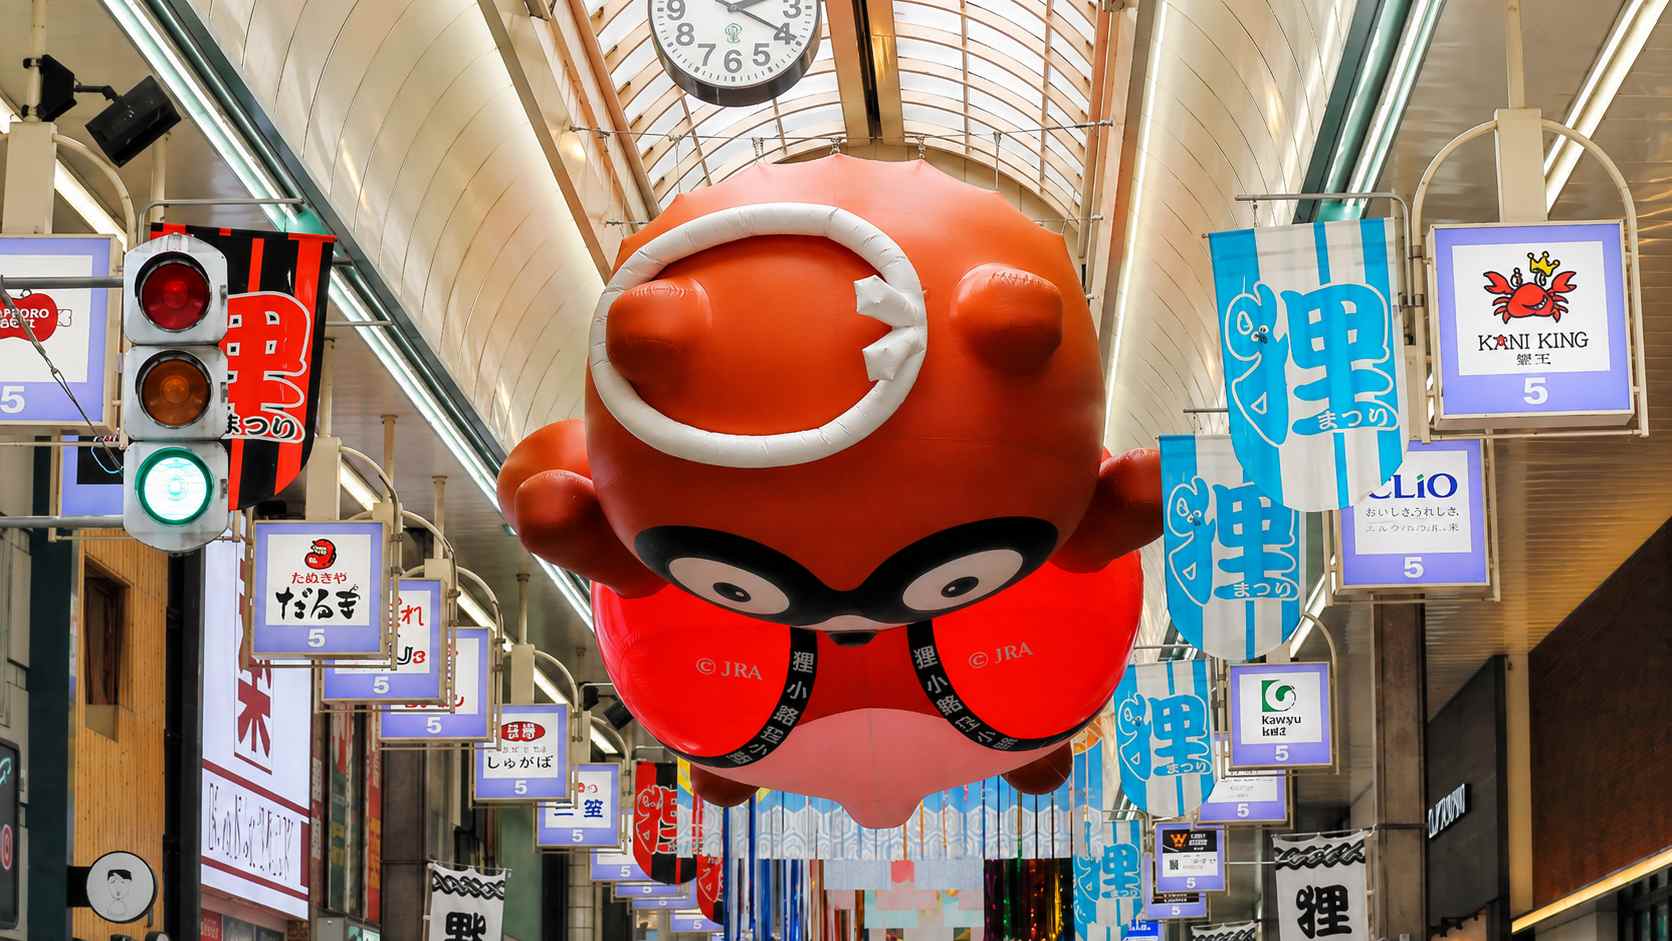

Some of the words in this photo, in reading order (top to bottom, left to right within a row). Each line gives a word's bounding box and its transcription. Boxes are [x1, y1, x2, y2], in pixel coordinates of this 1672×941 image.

[667, 0, 686, 21] 9
[676, 23, 695, 46] 8
[773, 22, 797, 45] 4
[697, 43, 716, 67] 7
[724, 50, 743, 73] 6
[752, 43, 771, 66] 5
[1478, 333, 1530, 351] KANI
[1537, 331, 1590, 349] KING
[0, 385, 26, 413] 5
[1523, 377, 1549, 405] 5
[1318, 407, 1389, 430] まつり
[1403, 556, 1425, 578] 5
[1233, 582, 1292, 598] まつり
[307, 628, 326, 648] 5
[995, 640, 1034, 665] JRA
[721, 661, 763, 681] JRA
[372, 675, 390, 694] 5
[426, 716, 442, 734] 5
[1274, 744, 1289, 762] 5
[514, 780, 527, 795] 5
[1237, 803, 1250, 817] 5
[572, 829, 584, 842] 5
[620, 866, 631, 877] 5
[1186, 877, 1196, 888] 5
[1171, 906, 1181, 915] 5
[693, 920, 702, 929] 5
